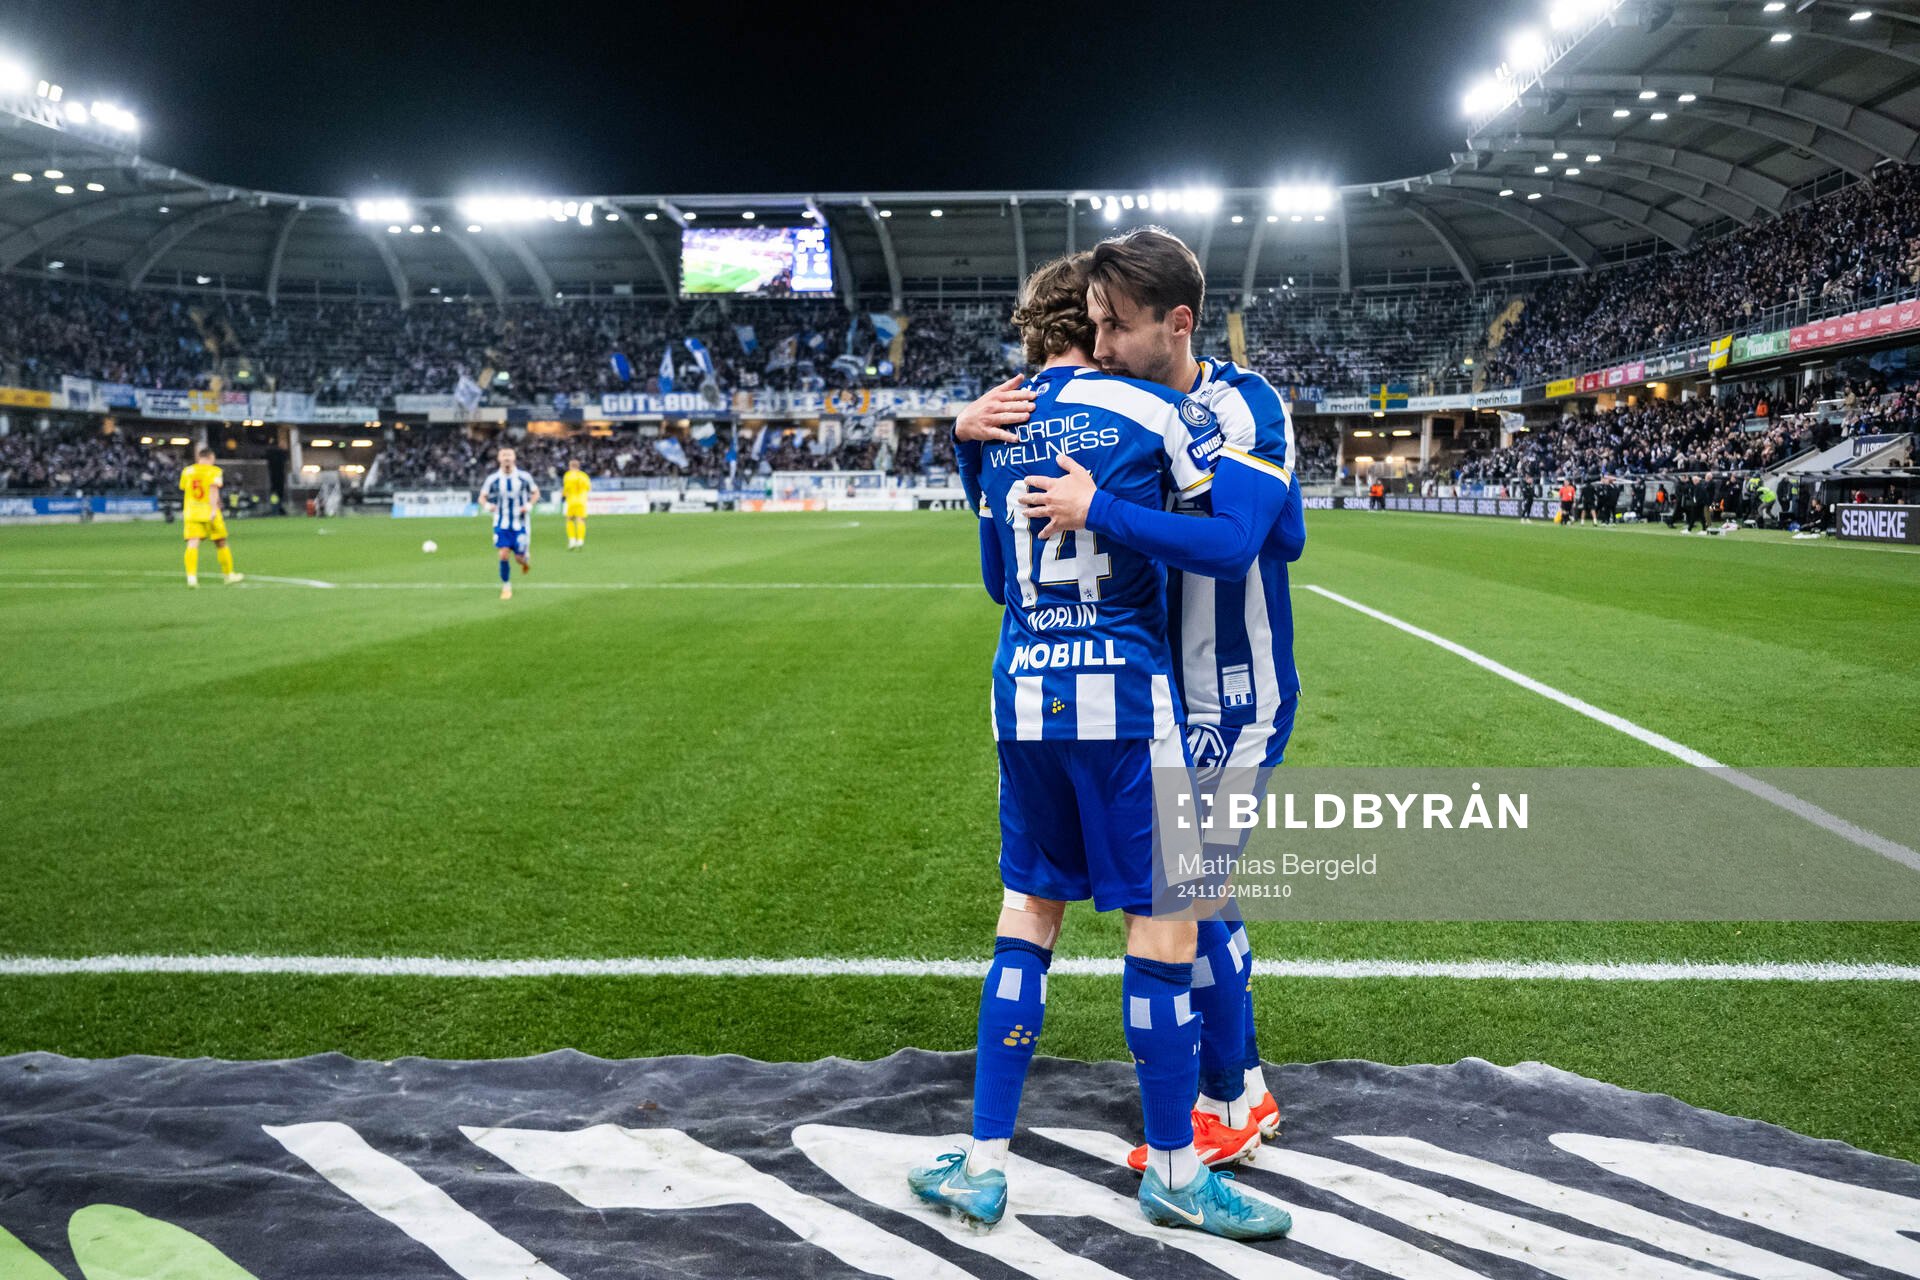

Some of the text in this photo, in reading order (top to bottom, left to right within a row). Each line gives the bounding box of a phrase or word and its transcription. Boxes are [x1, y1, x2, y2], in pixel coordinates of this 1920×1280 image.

[1330, 401, 1369, 411] merinf
[990, 427, 1120, 468] WELLNESS
[1192, 433, 1225, 459] UNIBE
[192, 480, 205, 499] 5
[1841, 509, 1906, 538] SERNEKE
[1006, 469, 1112, 609] 14
[1027, 604, 1097, 632] NORLIN
[1008, 639, 1126, 674] MOBILL
